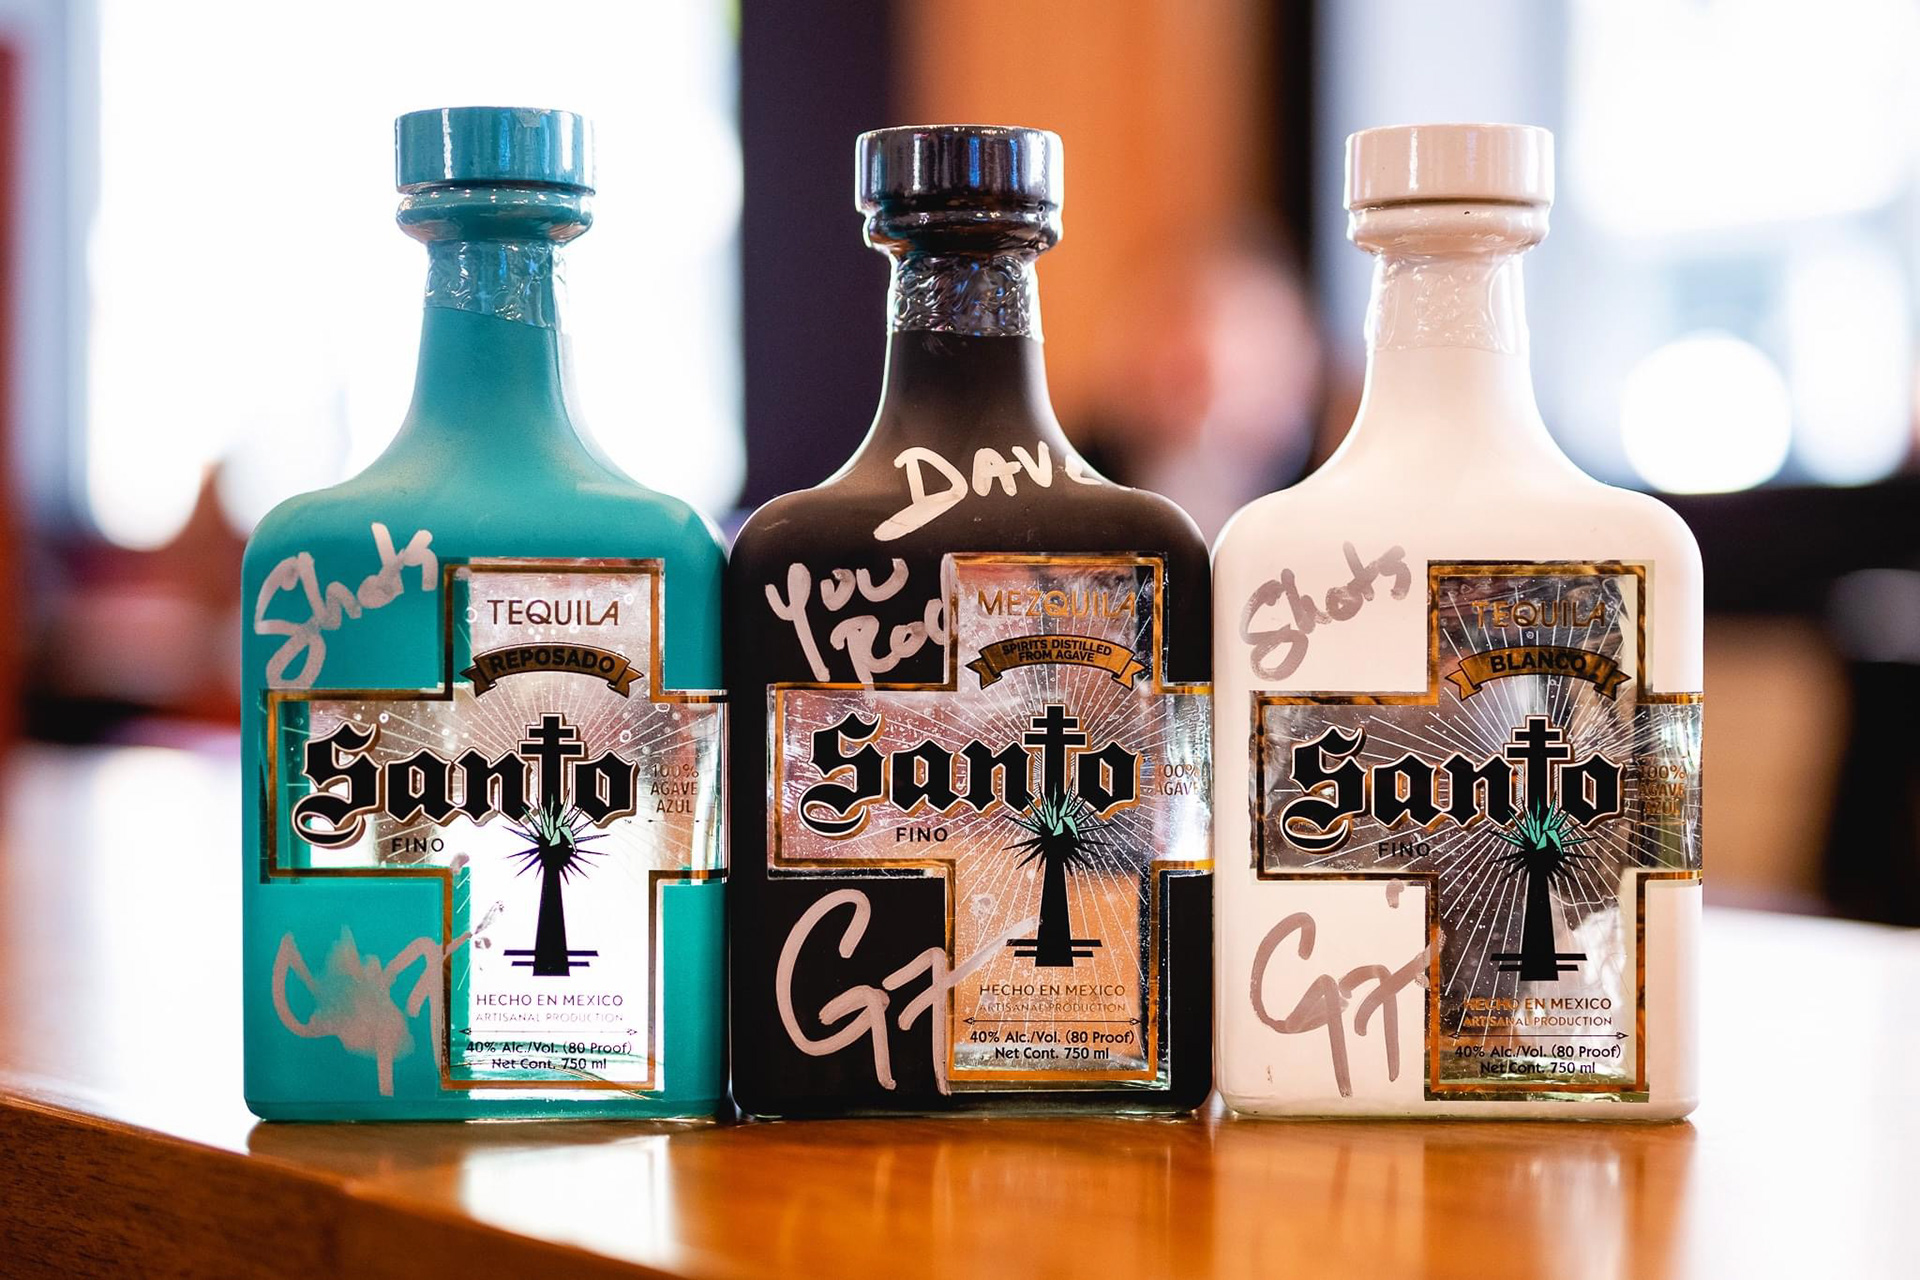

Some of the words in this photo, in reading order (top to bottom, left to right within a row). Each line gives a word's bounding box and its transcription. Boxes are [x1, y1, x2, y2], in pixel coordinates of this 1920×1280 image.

[977, 589, 1137, 618] MEZQUILA
[487, 599, 620, 626] TEQUILA
[1471, 600, 1606, 628] TEQUILA
[1002, 640, 1047, 655] SPIRITS
[1051, 639, 1112, 656] DISTILLED
[489, 648, 616, 675] REPOSADO
[1018, 651, 1052, 662] FROM
[1056, 651, 1095, 663] AGAVE
[1490, 652, 1587, 673] BLANCO
[651, 763, 699, 778] 100%
[800, 704, 1143, 837] Santo
[293, 713, 641, 849] Santo
[650, 781, 698, 796] AGAVE
[1156, 781, 1199, 796] AGAVE
[1280, 715, 1626, 855] Santo
[656, 799, 693, 813] AZUL
[896, 827, 948, 842] FINO
[392, 837, 444, 852] FINO
[1378, 842, 1431, 857] FINO
[979, 984, 1035, 996] HECHO
[1040, 984, 1060, 996] EN
[1065, 984, 1126, 996] MEXICO
[476, 994, 532, 1006] HECHO
[537, 994, 558, 1006] EN
[562, 994, 624, 1006] MEXICO
[979, 1003, 1046, 1013] ARTISANAL
[1050, 1002, 1126, 1013] PRODUCTION
[1463, 998, 1519, 1010] HECHO
[1524, 998, 1545, 1010] EN
[1551, 998, 1612, 1010] MEXICO
[475, 1012, 540, 1022] ARTISANAL
[546, 1012, 624, 1022] PRODUCTION
[1463, 1016, 1530, 1027] ARTISANAL
[1534, 1016, 1612, 1026] PRODUCTION
[970, 1031, 1000, 1044] 40%
[1005, 1031, 1061, 1044] Alc./Vol.
[1066, 1030, 1088, 1044] (80
[1092, 1030, 1134, 1044] Proof)
[466, 1041, 496, 1054] 40%
[501, 1041, 558, 1054] Alc./Vol.
[563, 1041, 586, 1054] (80
[590, 1041, 632, 1055] Proof)
[995, 1047, 1021, 1060] Net
[1023, 1047, 1059, 1060] Cont.
[1065, 1047, 1090, 1060] 750
[1093, 1047, 1109, 1060] ml
[1454, 1046, 1485, 1058] 40%
[1490, 1046, 1547, 1058] Alc./Vol.
[1551, 1045, 1574, 1058] (80
[1579, 1045, 1621, 1058] Proof)
[492, 1058, 518, 1070] Net
[520, 1058, 556, 1070] Cont.
[561, 1058, 587, 1070] 750
[591, 1058, 607, 1070] ml
[1480, 1062, 1506, 1074] Net
[1509, 1062, 1545, 1074] Cont.
[1550, 1062, 1575, 1074] 750
[1580, 1062, 1596, 1074] ml
